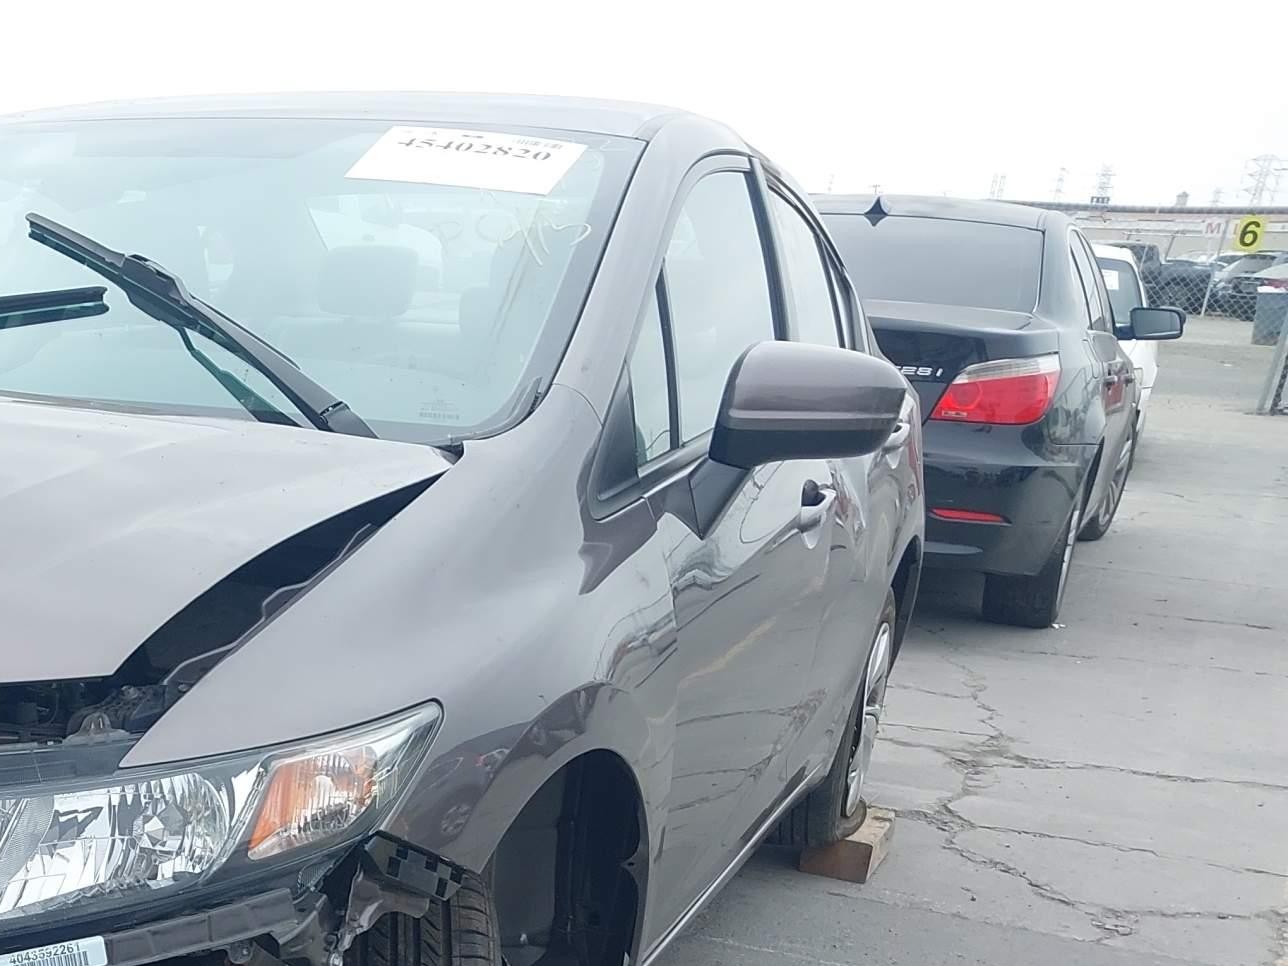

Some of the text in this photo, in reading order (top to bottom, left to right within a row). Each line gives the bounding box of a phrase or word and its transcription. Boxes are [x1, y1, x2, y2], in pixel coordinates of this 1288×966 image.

[397, 137, 552, 162] 45402820
[1239, 220, 1261, 247] 6
[8, 941, 81, 965] 4043592261
